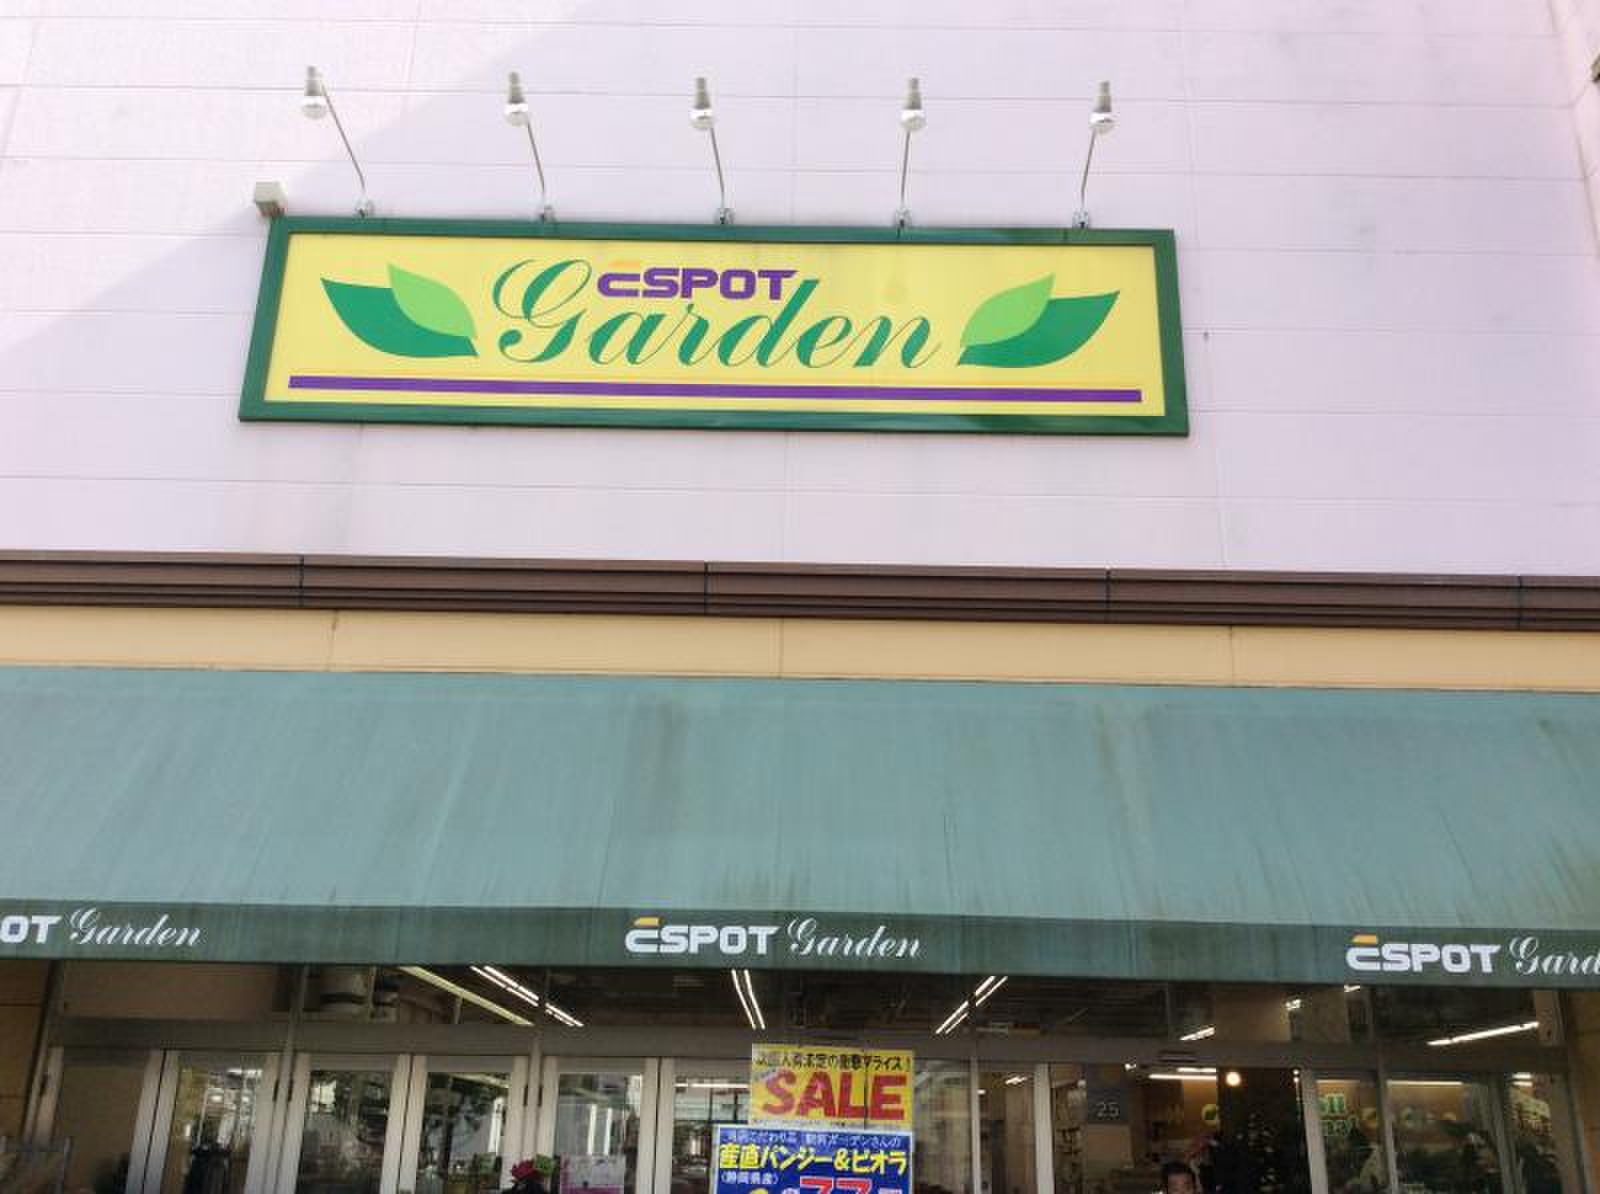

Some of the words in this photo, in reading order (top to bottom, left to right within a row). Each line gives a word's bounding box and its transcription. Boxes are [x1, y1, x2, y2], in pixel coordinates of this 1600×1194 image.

[597, 263, 798, 300] ESPOT
[492, 259, 940, 368] Garden
[69, 908, 204, 946] Garden
[625, 917, 781, 955] ESPOT
[787, 917, 922, 958] Garden
[1346, 934, 1501, 973] ESPOT
[764, 1070, 906, 1120] SALE
